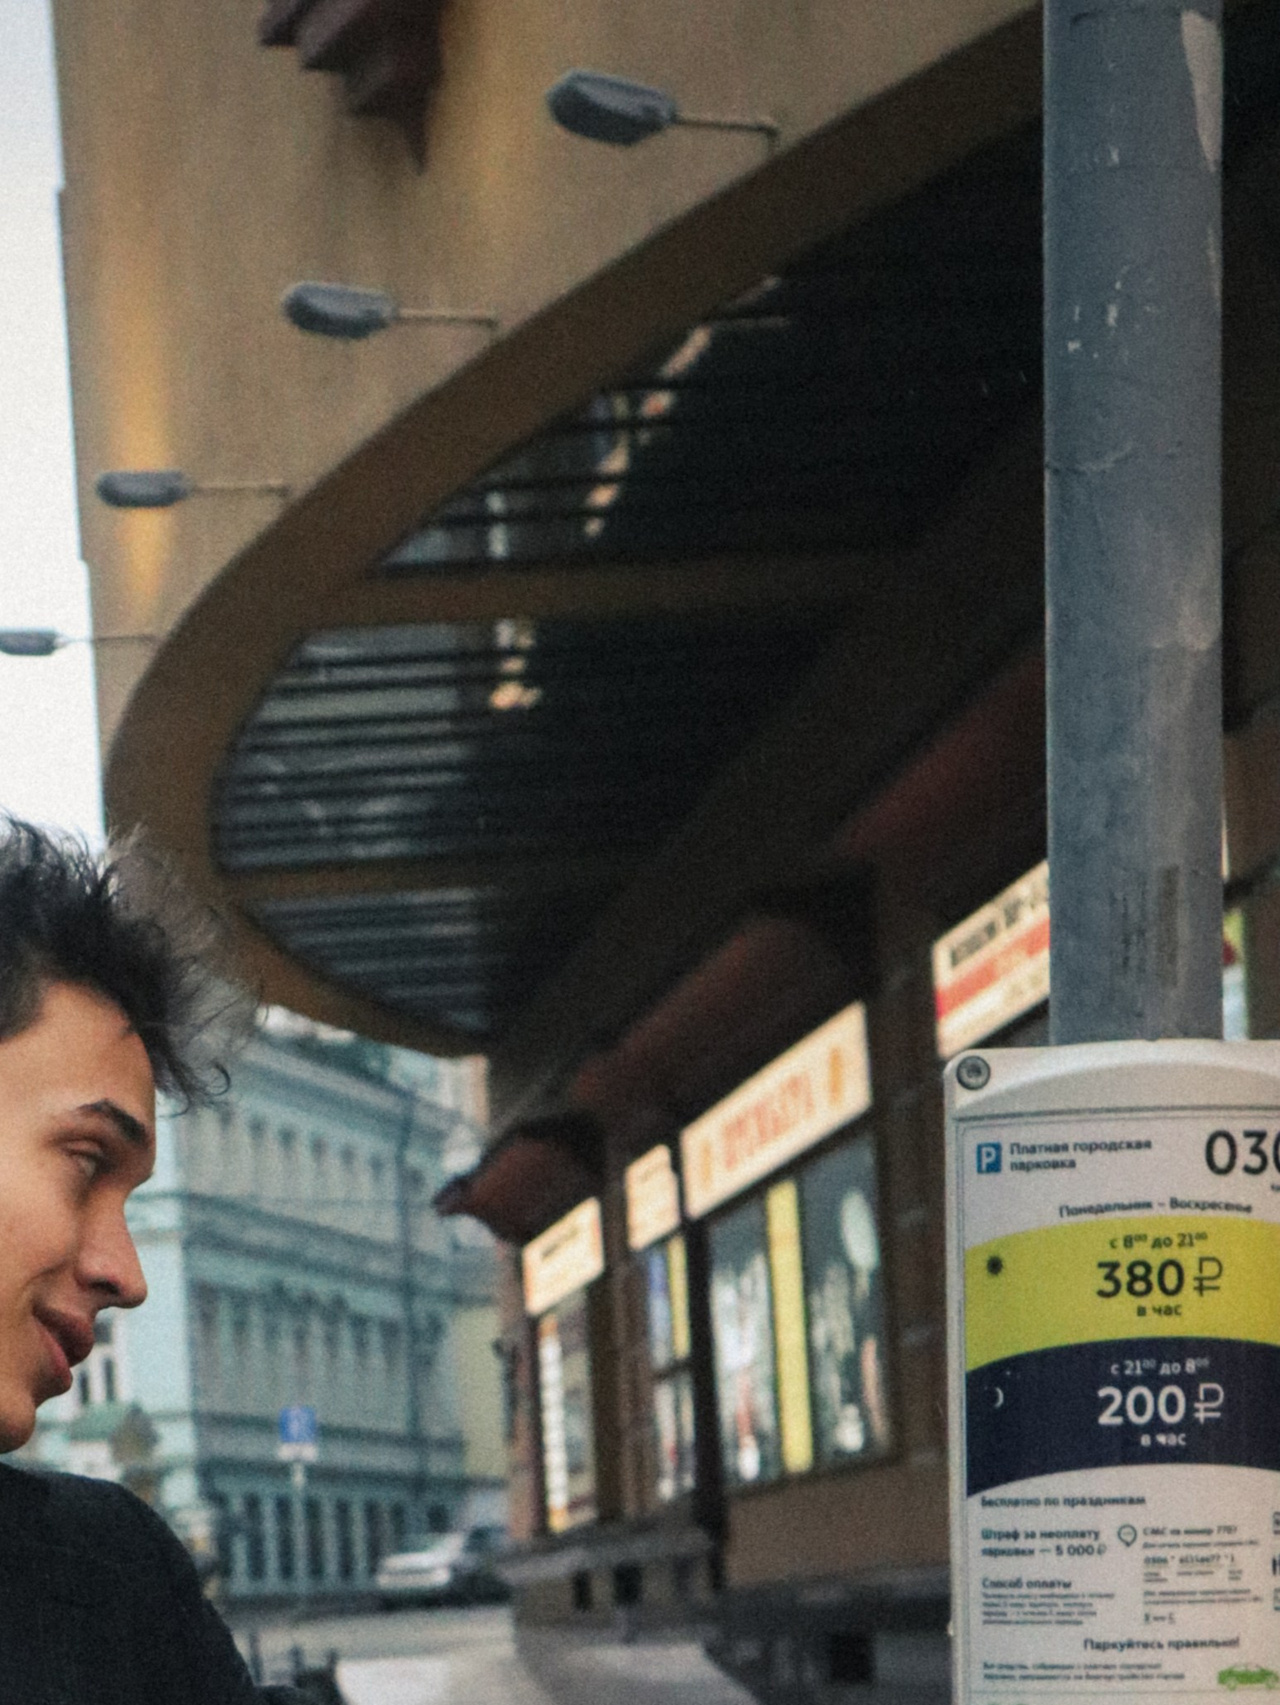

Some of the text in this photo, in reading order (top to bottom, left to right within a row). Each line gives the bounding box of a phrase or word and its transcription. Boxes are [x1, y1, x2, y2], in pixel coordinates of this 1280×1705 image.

[1010, 1140, 1152, 1157] Платная городская
[1205, 1130, 1280, 1177] 03
[1010, 1158, 1077, 1174] парковка
[1059, 1200, 1153, 1218] Понедельник
[1169, 1197, 1252, 1214] Воскресенье
[1109, 1238, 1118, 1249] с
[1151, 1237, 1174, 1250] до
[1136, 1304, 1183, 1317] в час
[1110, 1363, 1120, 1375] с
[1159, 1361, 1181, 1375] до
[1155, 1433, 1187, 1446] час
[1044, 1497, 1060, 1507] по
[981, 1529, 1020, 1542] Штраф
[1039, 1529, 1100, 1542] неоплату
[981, 1577, 1072, 1590] Способ оплаты
[1083, 1637, 1164, 1653] Паркуйтесь
